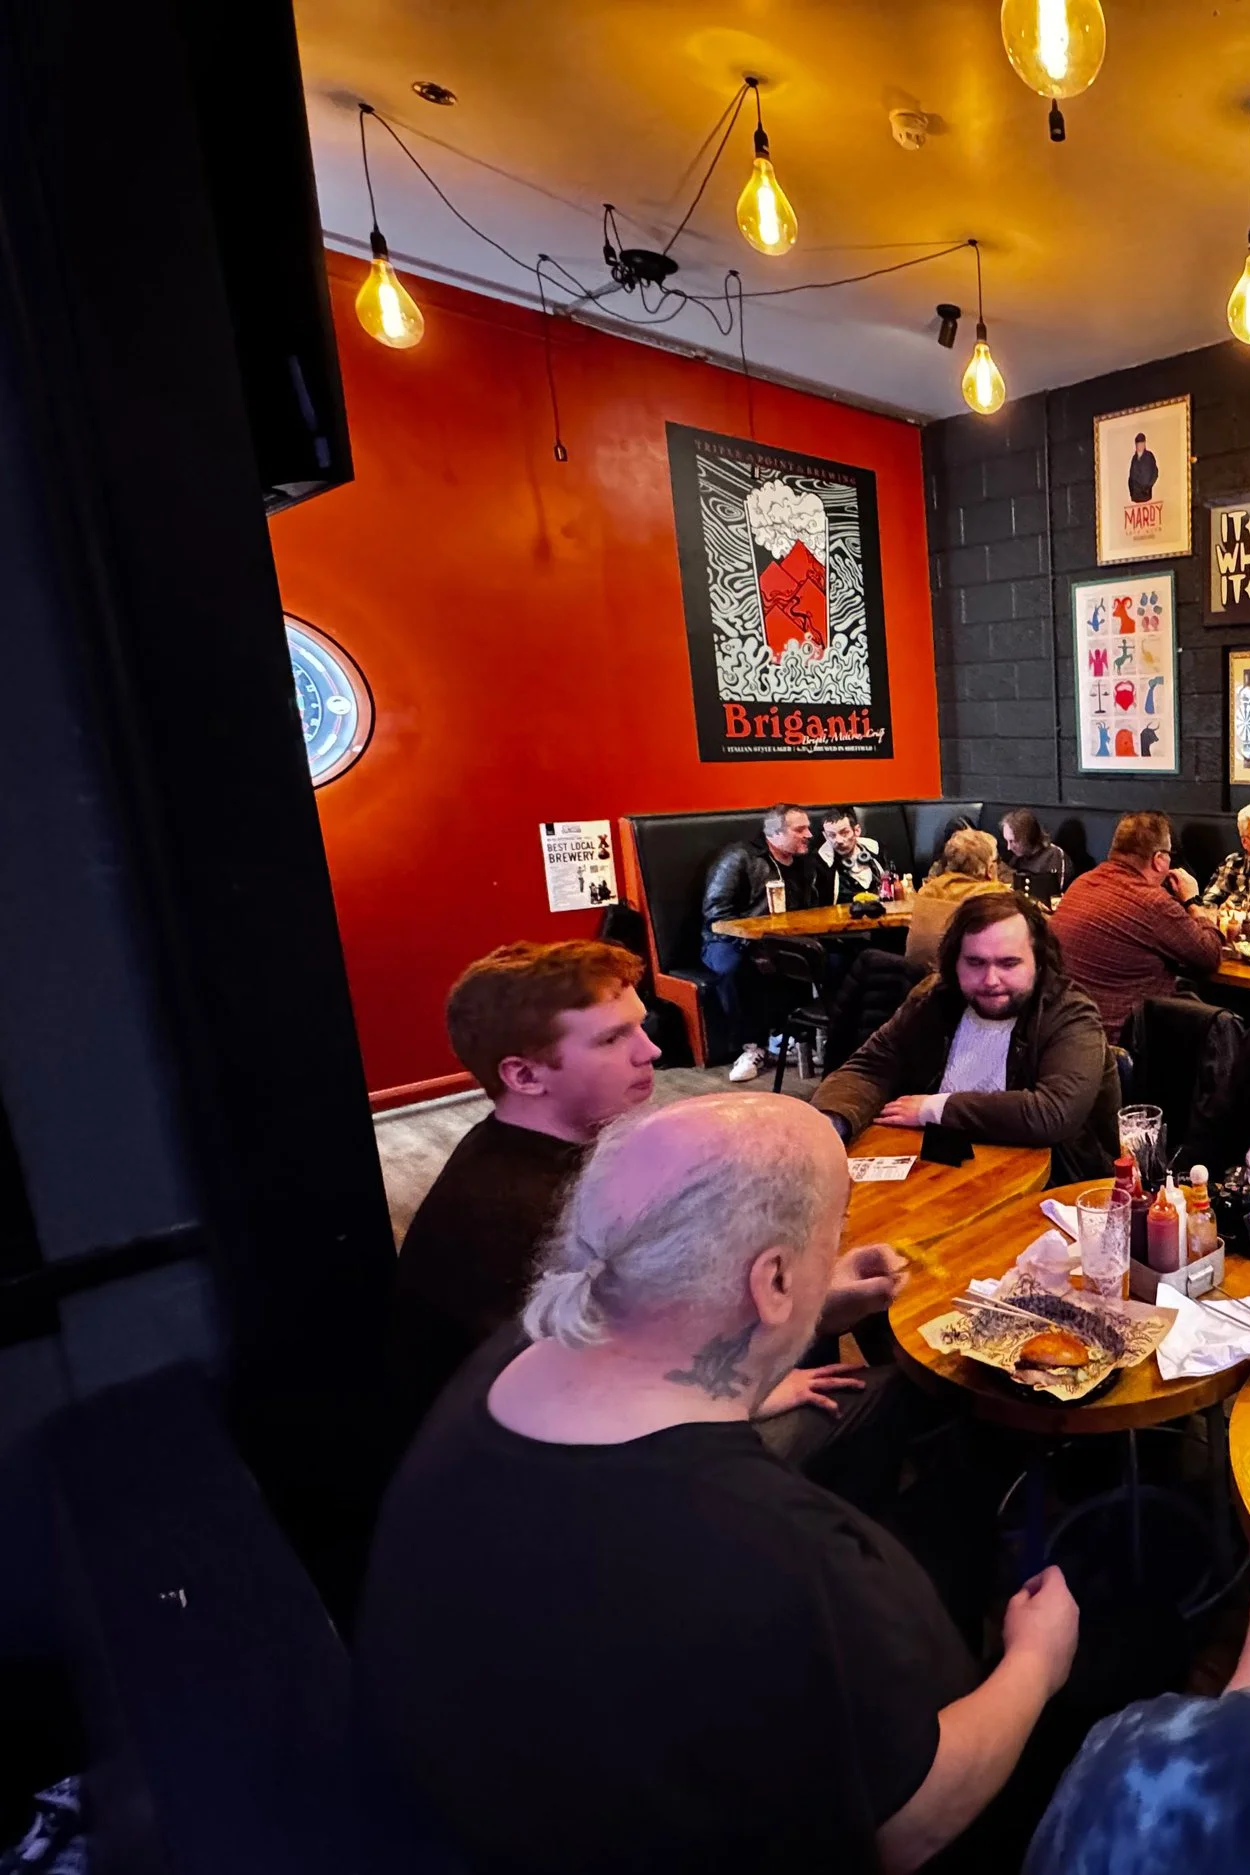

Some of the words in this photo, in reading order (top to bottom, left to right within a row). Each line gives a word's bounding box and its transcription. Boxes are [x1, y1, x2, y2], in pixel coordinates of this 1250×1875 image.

[757, 454, 795, 473] POINT
[805, 466, 857, 486] BREWING
[1124, 504, 1163, 530] MARDY
[1221, 511, 1247, 543] IT
[1221, 574, 1246, 605] IT
[723, 703, 870, 745] Briganti
[547, 843, 567, 852] BEST
[571, 841, 596, 851] LOCAL
[548, 851, 595, 863] BREWERY
